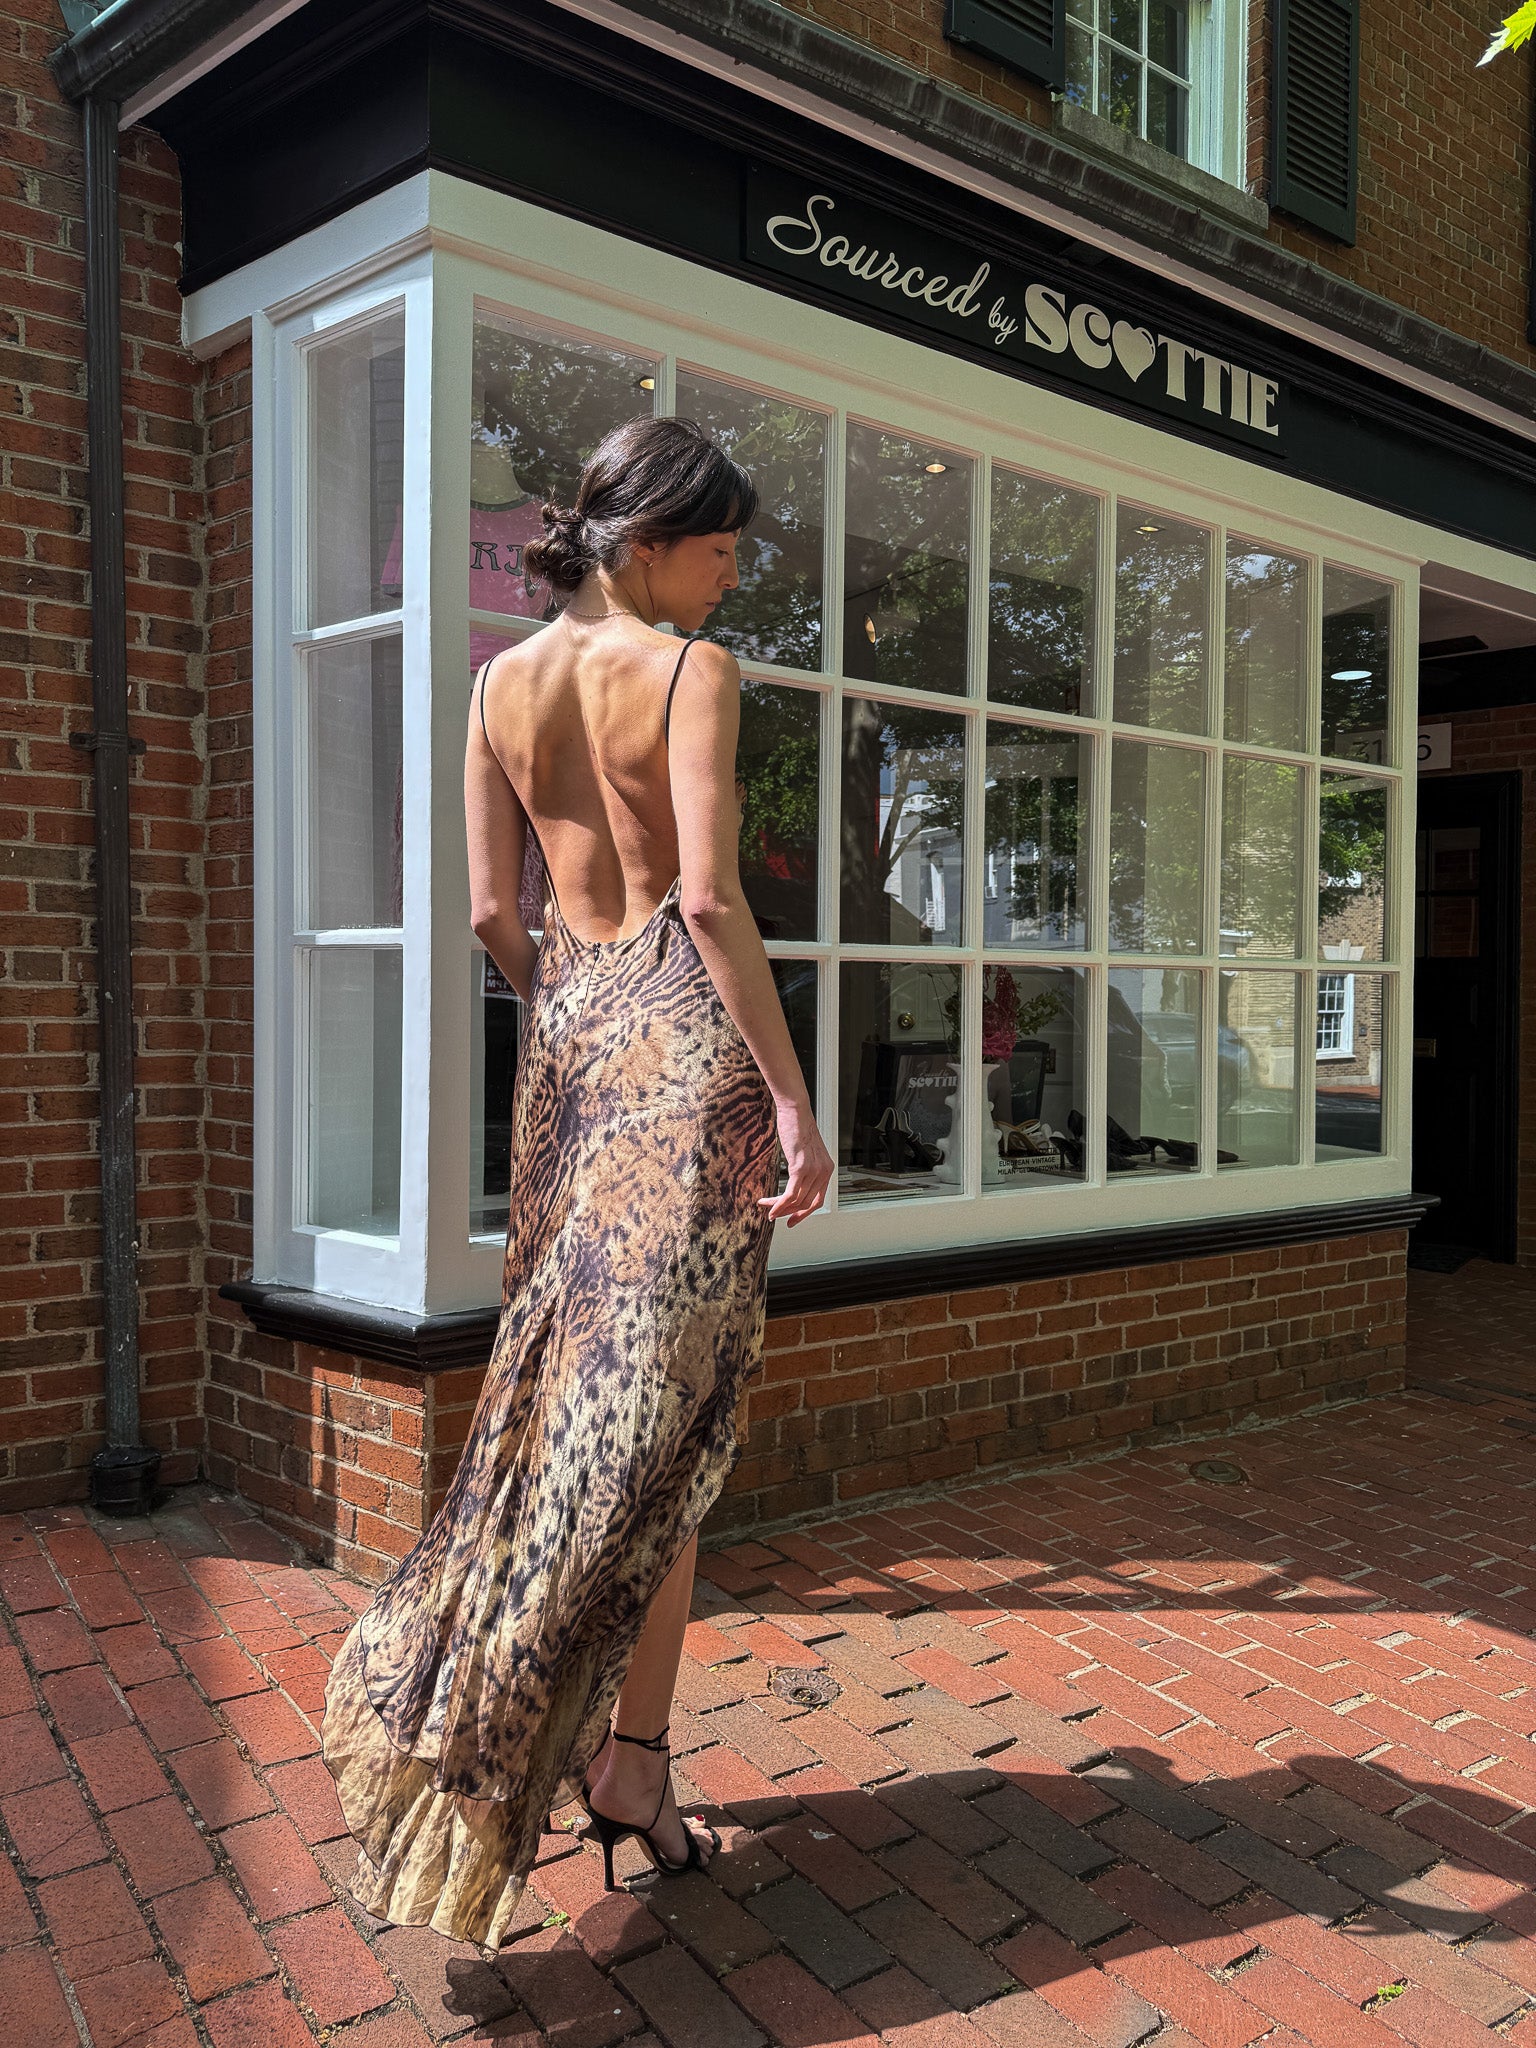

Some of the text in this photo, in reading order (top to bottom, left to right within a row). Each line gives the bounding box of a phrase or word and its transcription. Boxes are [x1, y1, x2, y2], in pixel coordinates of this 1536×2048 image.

[766, 195, 990, 317] Sourced
[988, 296, 1018, 345] by
[998, 1156, 1057, 1167] EUROPEAN VINTAGE
